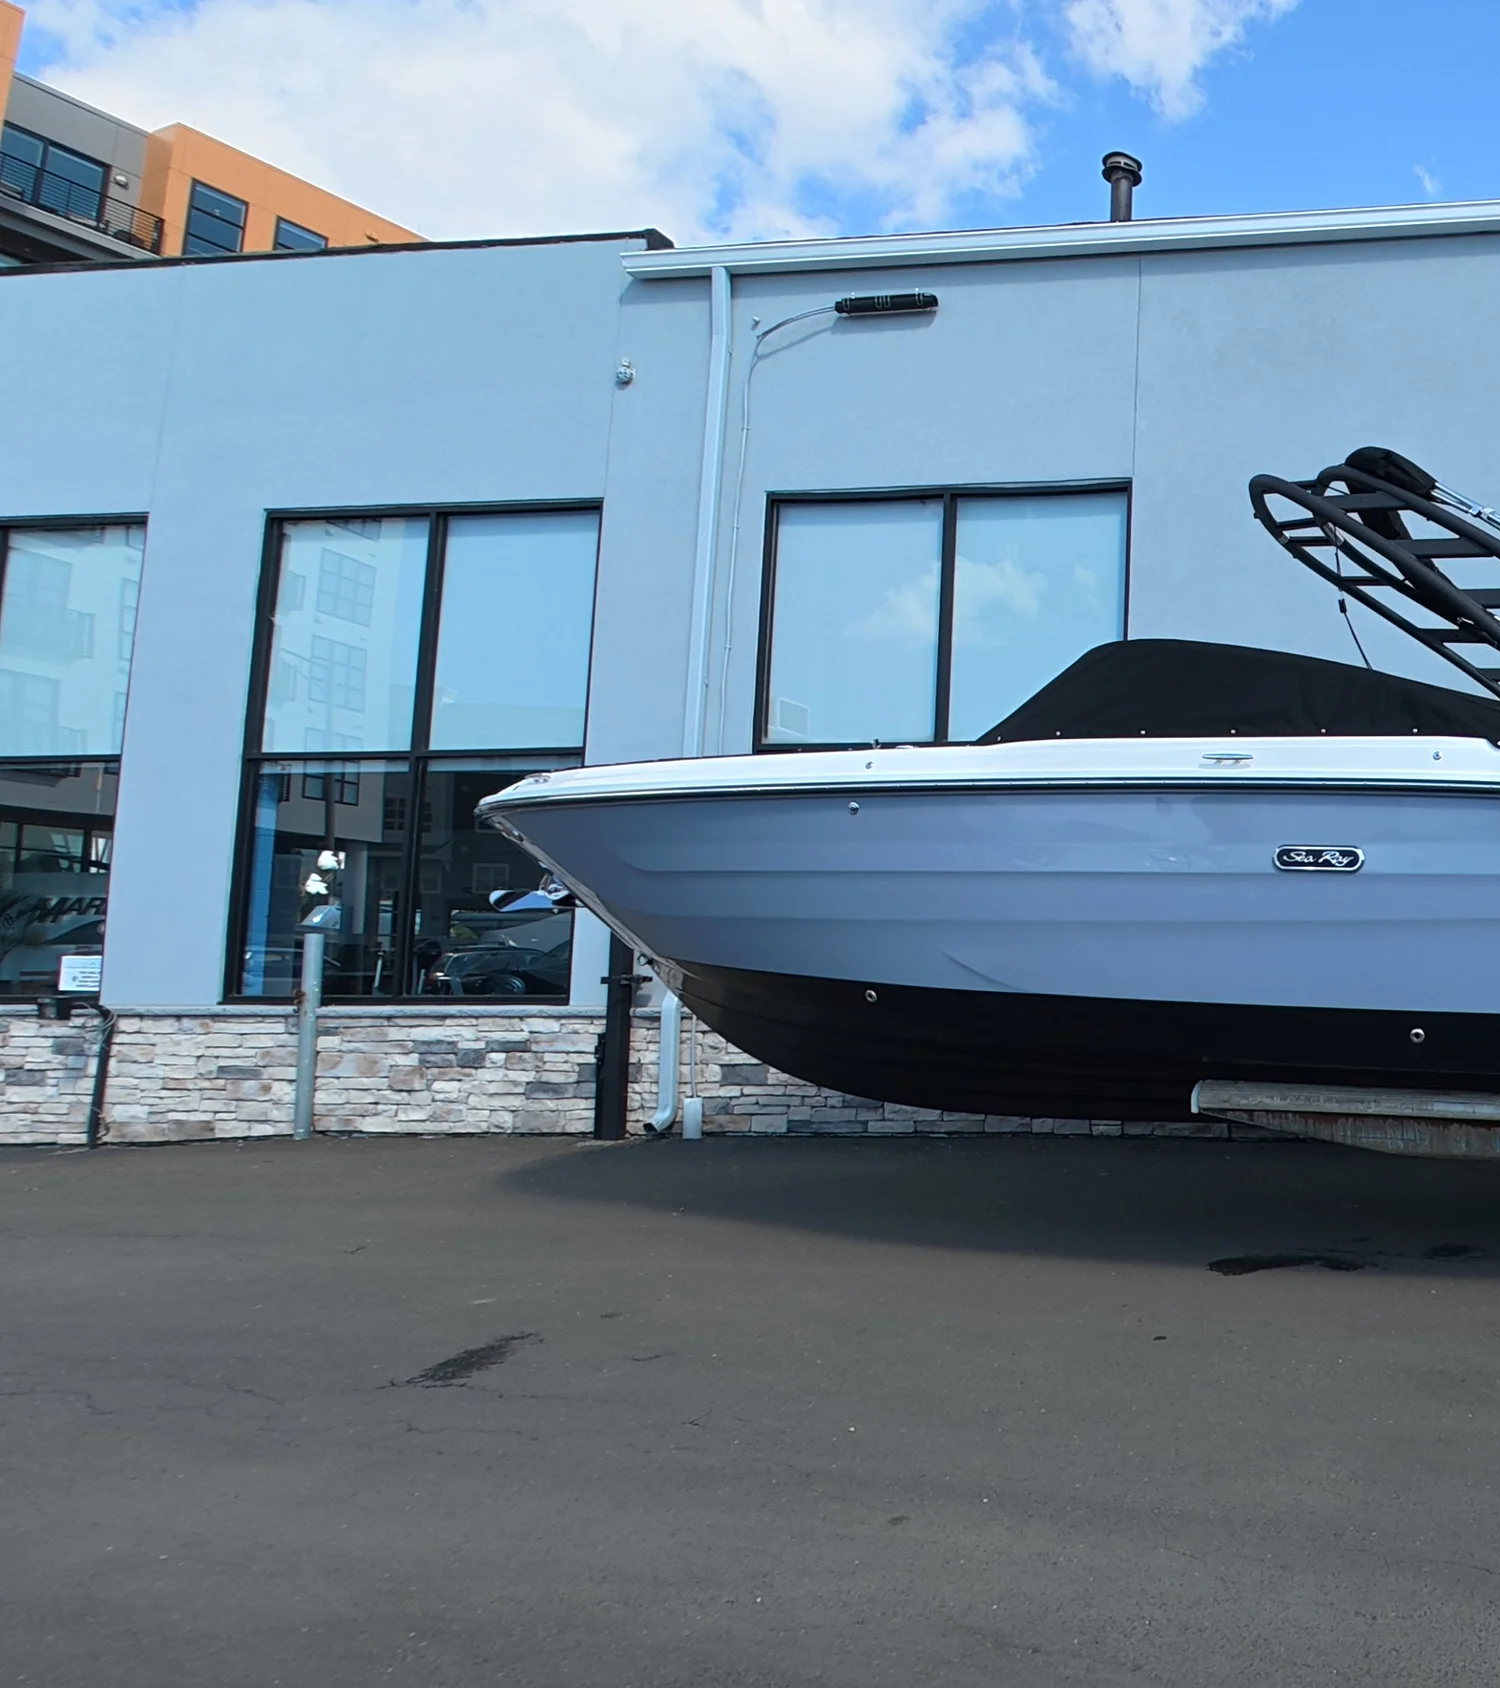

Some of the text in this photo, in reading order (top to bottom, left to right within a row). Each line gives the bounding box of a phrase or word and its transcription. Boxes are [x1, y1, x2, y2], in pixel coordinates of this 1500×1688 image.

[1282, 851, 1354, 867] Sea Ray
[34, 896, 106, 923] MAR
